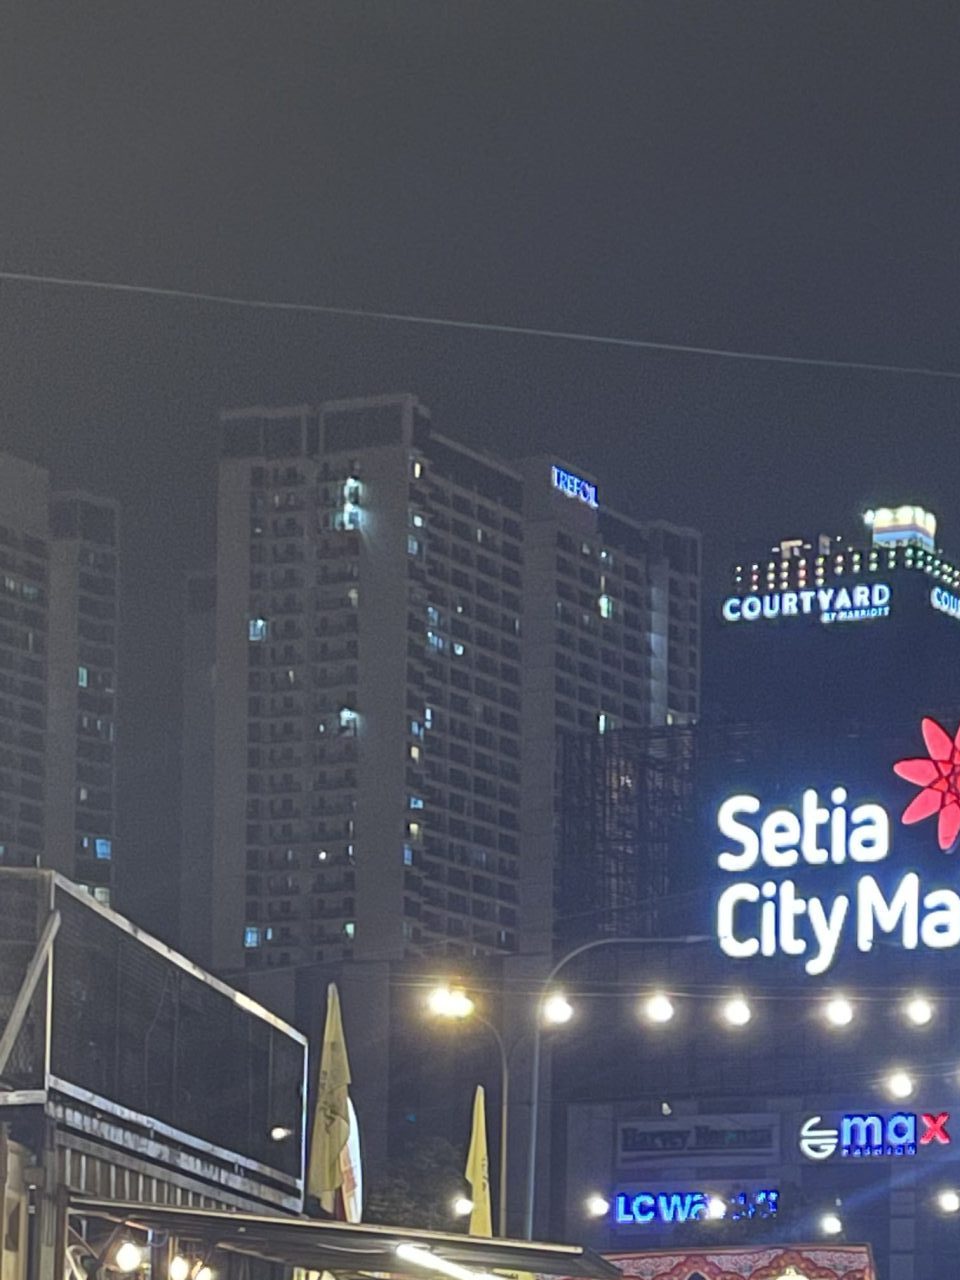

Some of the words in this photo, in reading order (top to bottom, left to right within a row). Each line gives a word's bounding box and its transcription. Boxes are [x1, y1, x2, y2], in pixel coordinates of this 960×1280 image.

[550, 465, 599, 510] TREFOIL
[722, 584, 891, 621] COURTYARD
[717, 787, 889, 872] Setia
[717, 879, 849, 975] City
[840, 1112, 950, 1145] max
